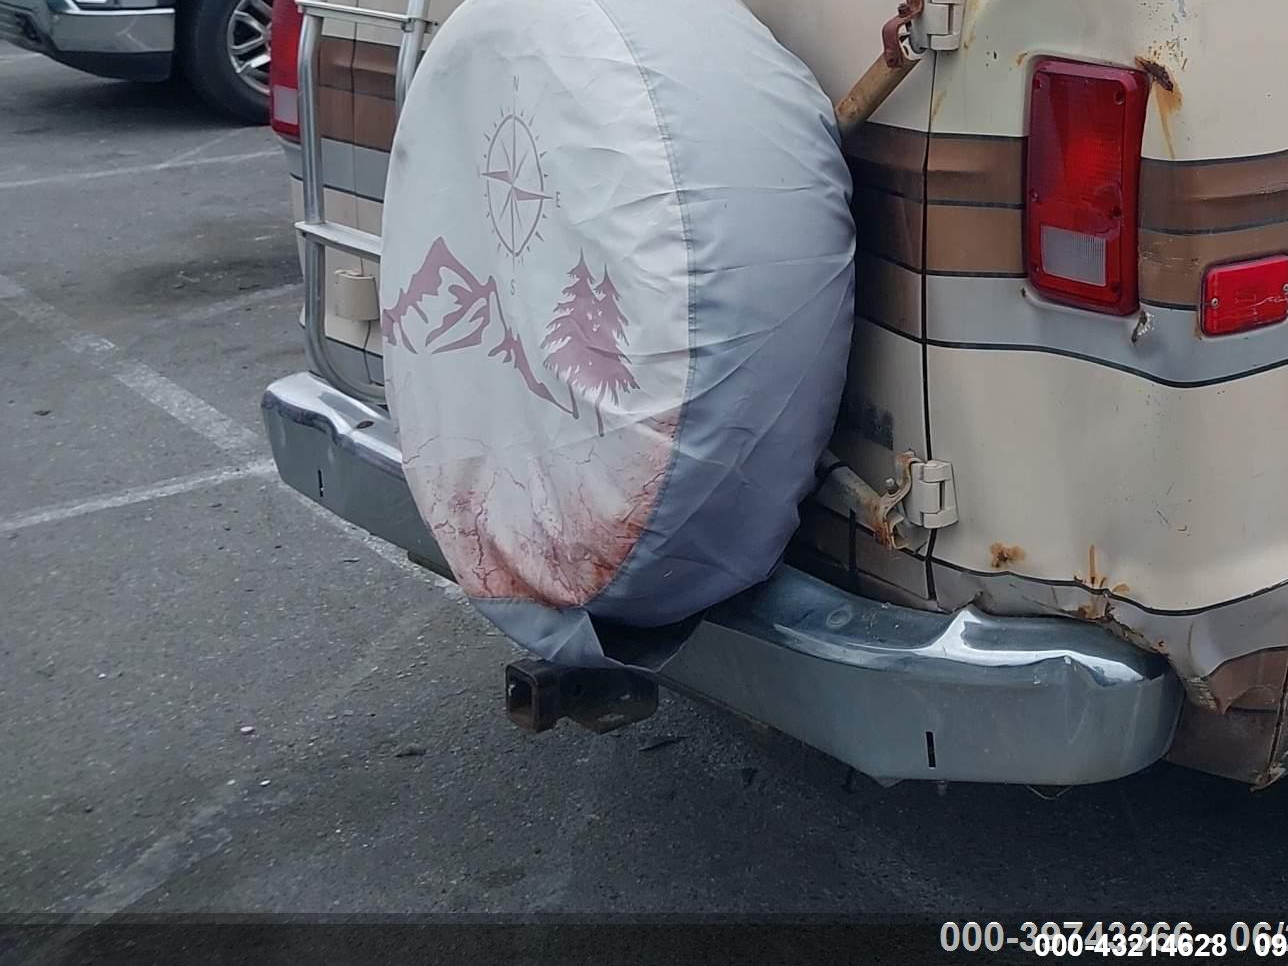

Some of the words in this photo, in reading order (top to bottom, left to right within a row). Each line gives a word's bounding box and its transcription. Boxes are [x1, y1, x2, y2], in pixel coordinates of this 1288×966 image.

[512, 75, 520, 91] N
[555, 191, 561, 208] E
[511, 279, 516, 296] S
